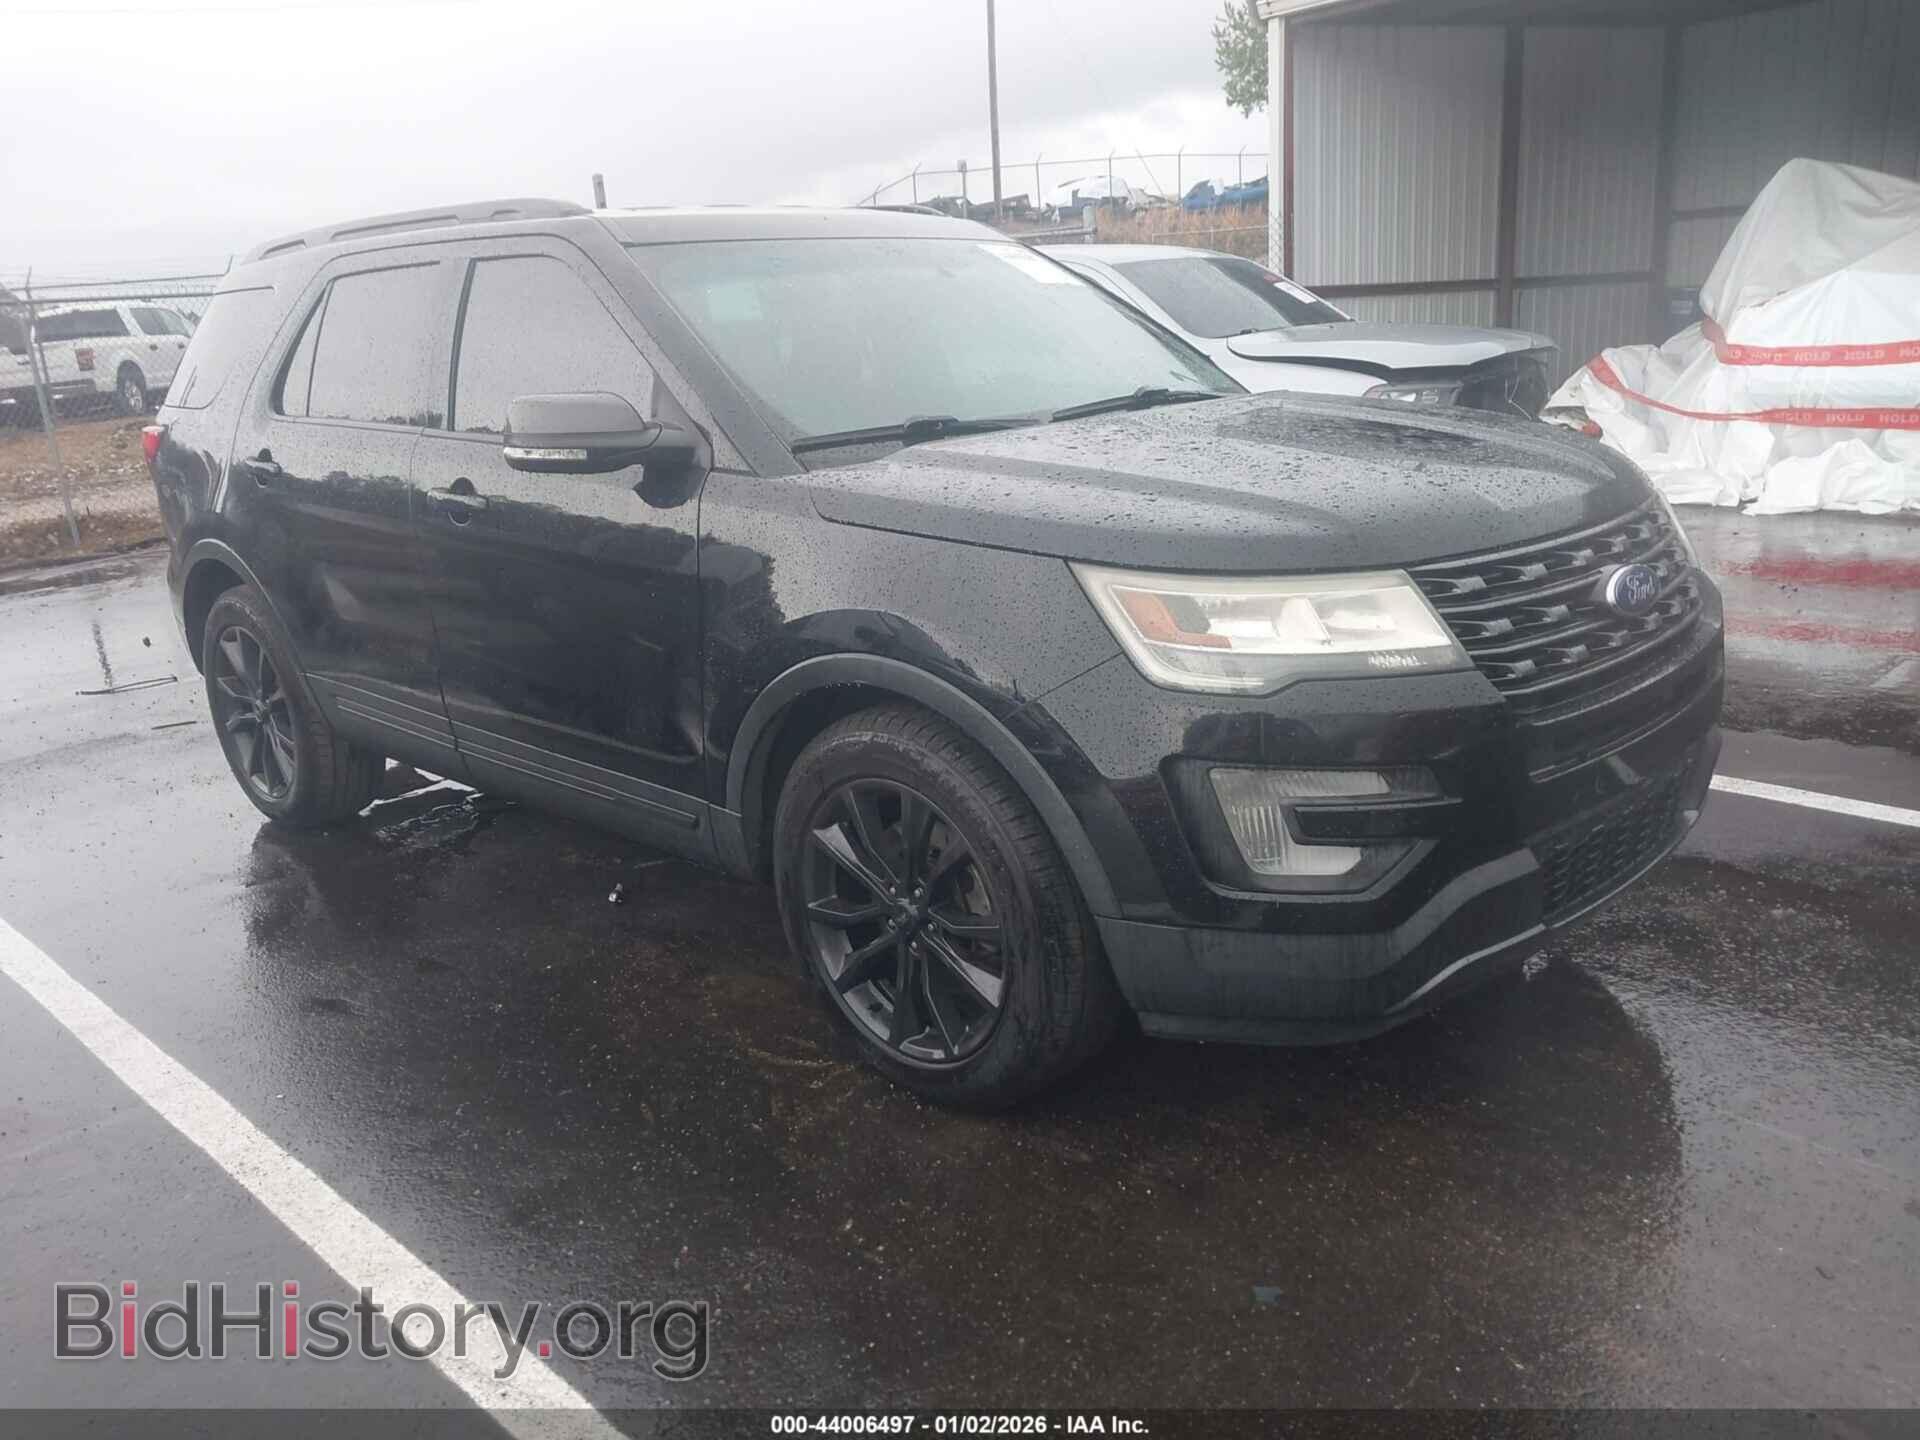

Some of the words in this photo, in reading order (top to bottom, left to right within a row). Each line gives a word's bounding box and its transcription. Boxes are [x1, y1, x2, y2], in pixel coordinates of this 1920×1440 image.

[1794, 351, 1831, 361] HOLD
[1844, 350, 1886, 361] HOLD
[1826, 413, 1864, 424] HOLD
[1879, 414, 1919, 425] HOLD
